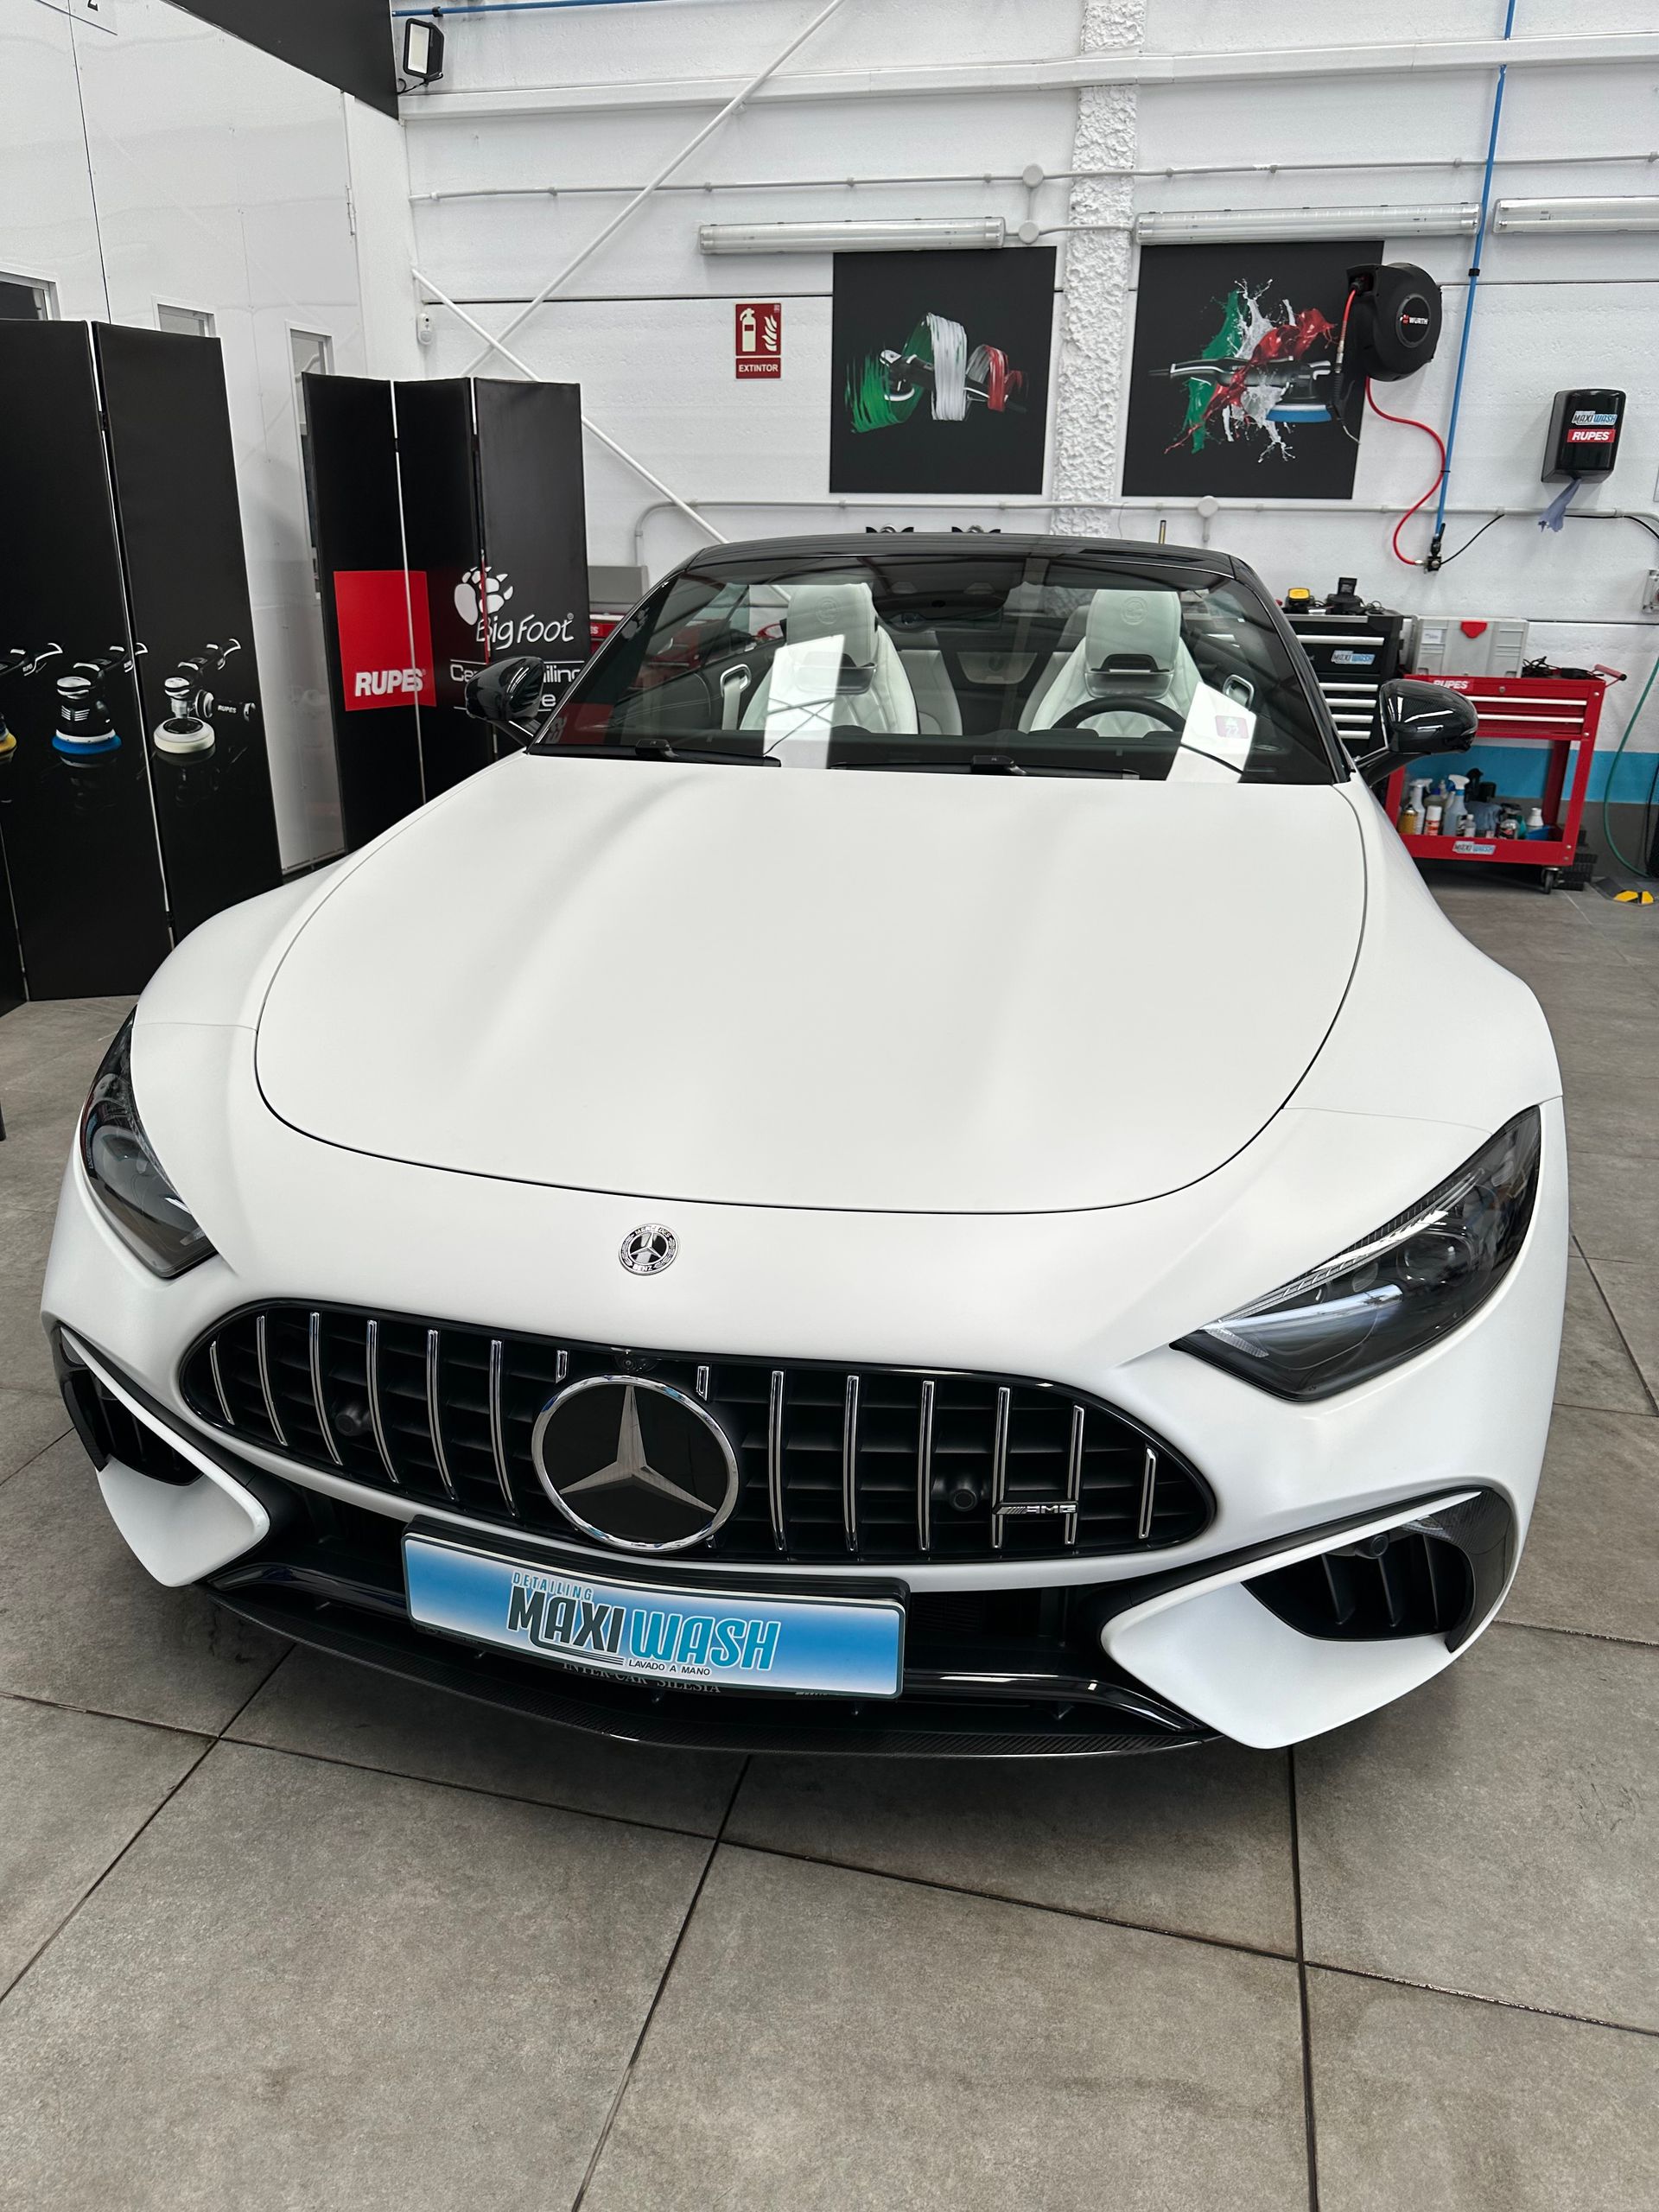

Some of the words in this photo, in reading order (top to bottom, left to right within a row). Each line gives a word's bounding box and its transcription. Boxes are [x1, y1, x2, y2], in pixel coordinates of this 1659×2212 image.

[738, 364, 779, 372] EXTINTOR
[1573, 414, 1593, 423] MAXI
[1593, 415, 1617, 423] WASH
[1572, 431, 1611, 441] RUPES
[354, 668, 423, 697] RUPES
[632, 1263, 653, 1272] BENZ
[512, 1572, 593, 1601] DETAILING
[507, 1586, 625, 1654] MAXI
[631, 1610, 781, 1670] WASH
[628, 1659, 665, 1672] LAVADO
[681, 1667, 710, 1676] MANO
